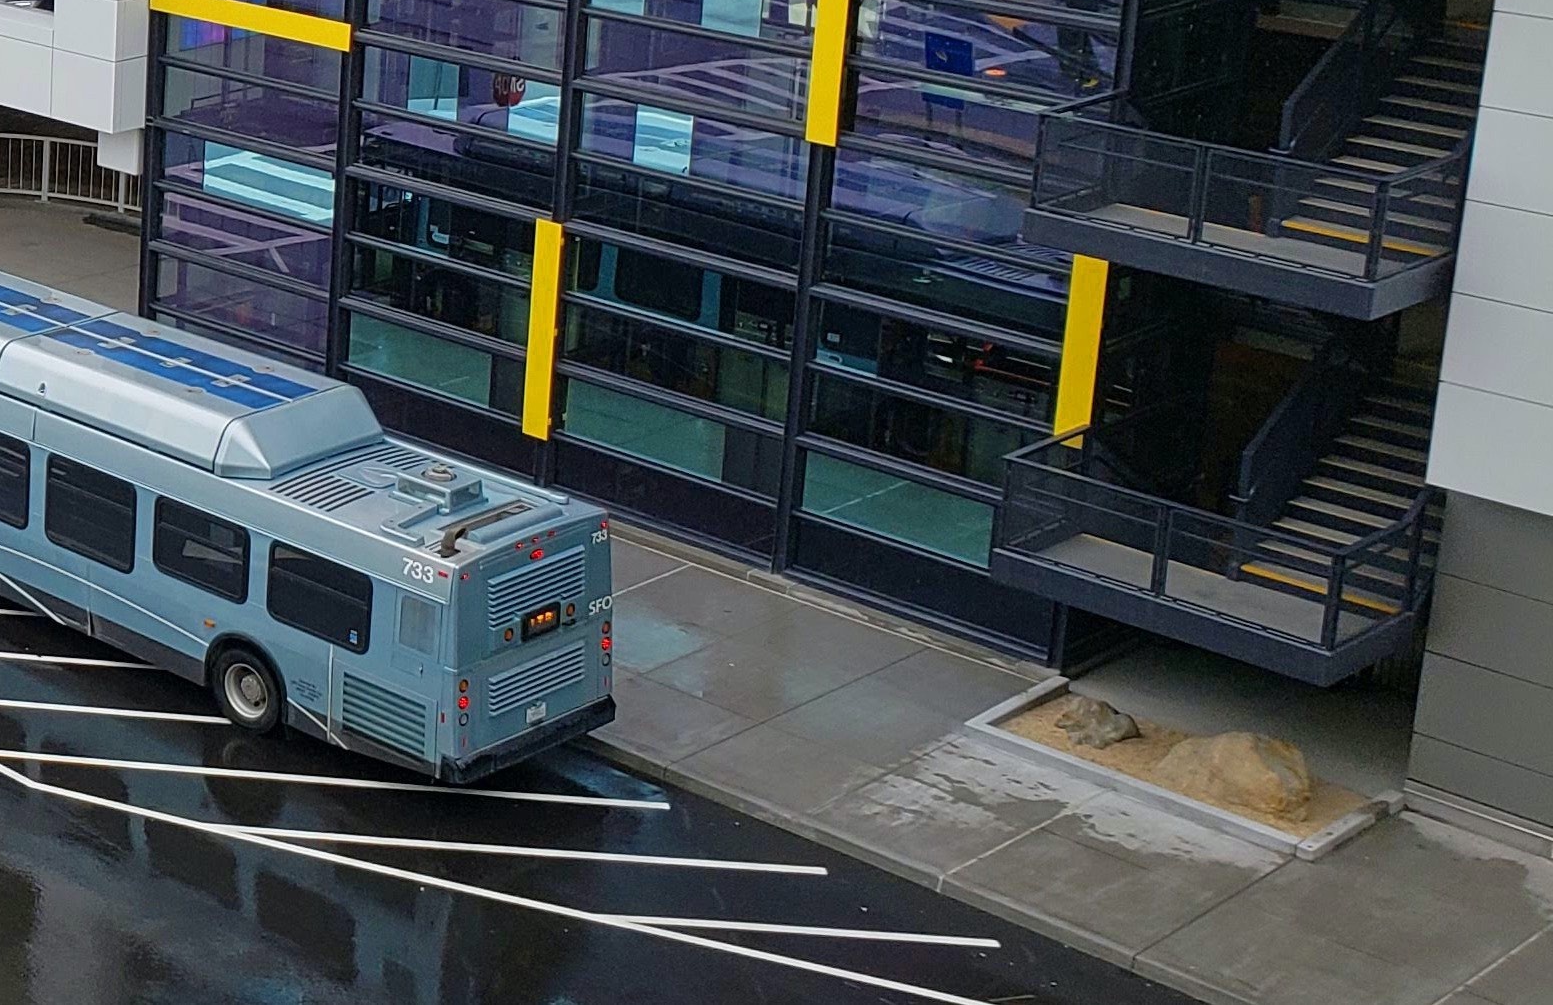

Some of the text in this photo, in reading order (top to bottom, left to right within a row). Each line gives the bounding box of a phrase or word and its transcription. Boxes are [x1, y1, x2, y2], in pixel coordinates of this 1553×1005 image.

[591, 529, 608, 544] 733
[402, 557, 434, 584] 733
[588, 595, 613, 616] SFO
